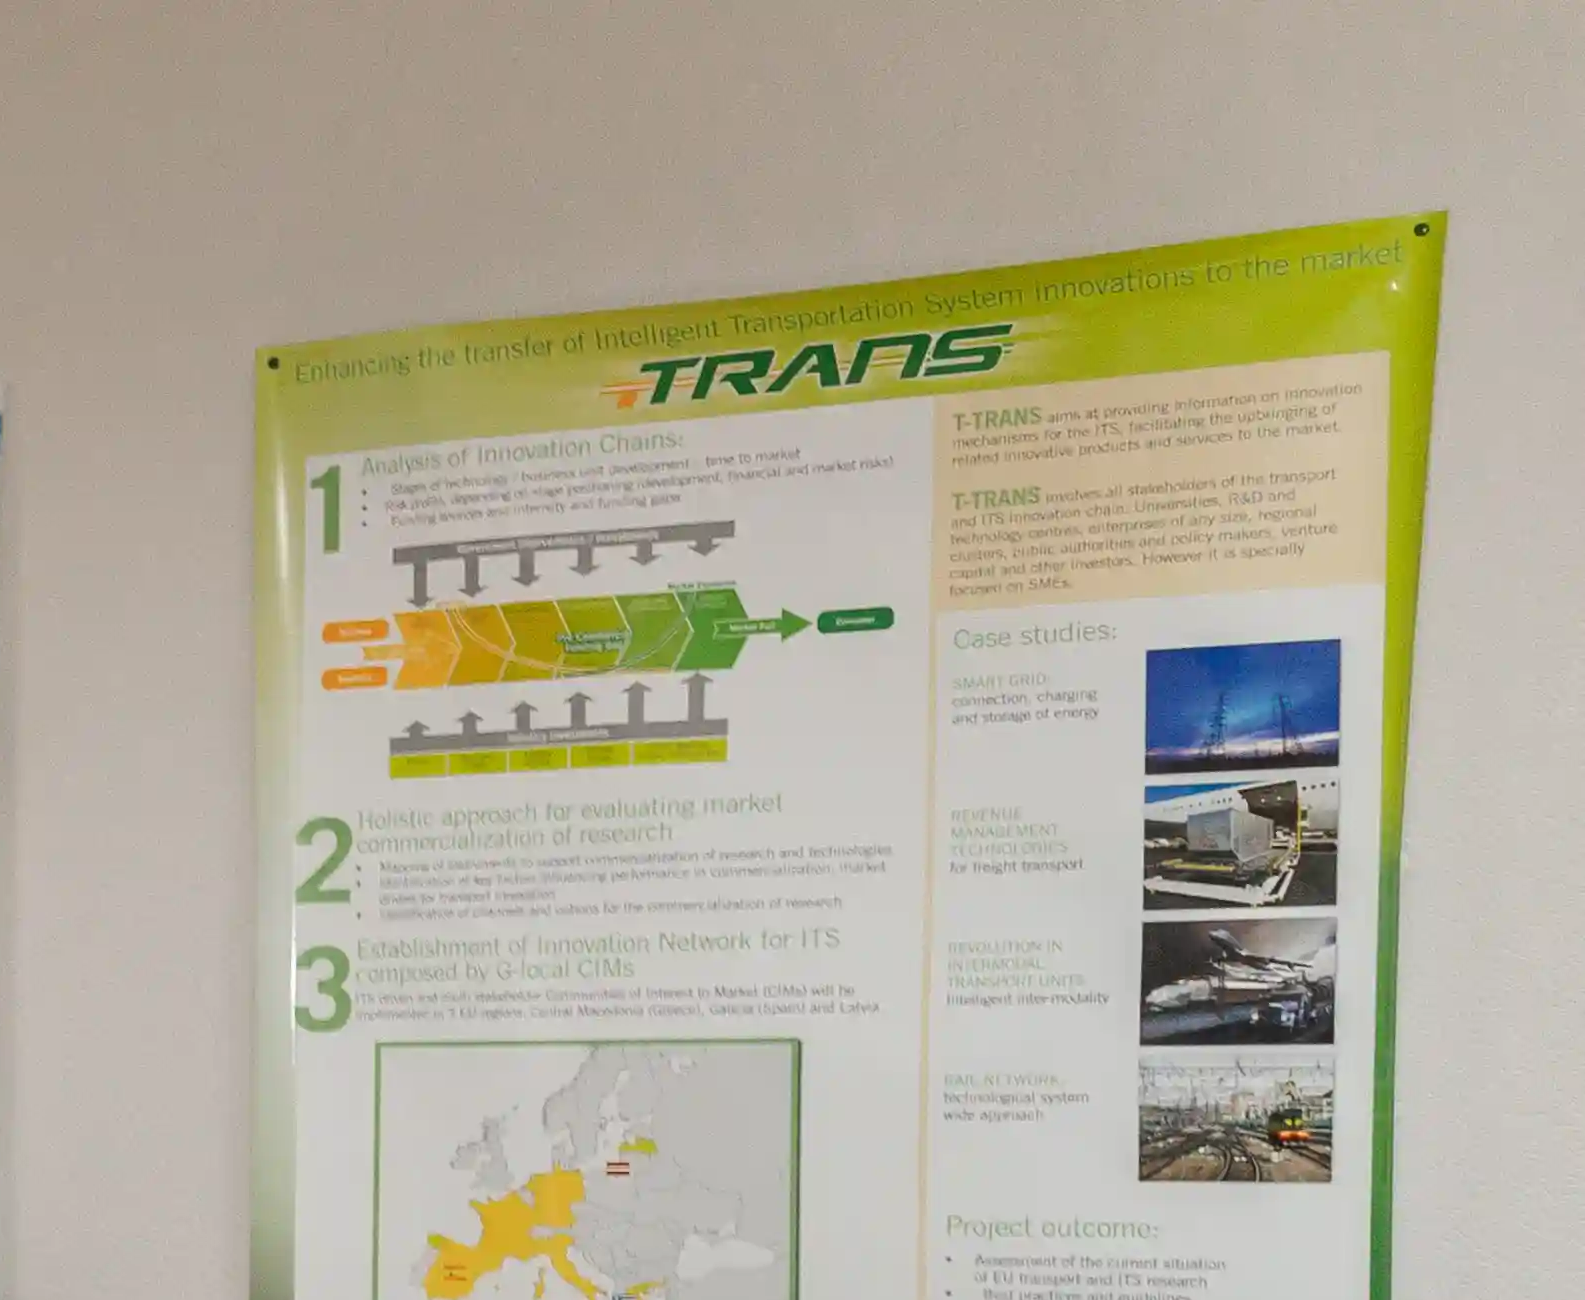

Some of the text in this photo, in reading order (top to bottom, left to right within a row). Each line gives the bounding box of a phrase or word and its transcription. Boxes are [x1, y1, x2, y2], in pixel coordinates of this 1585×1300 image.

[296, 239, 1401, 384] Enhancing the transfer of Intelligent Transportation System innovations to the market
[953, 405, 1042, 433] T-TRANS
[361, 432, 683, 478] Analysis of Innovation Chains:
[308, 465, 342, 554] 1
[952, 486, 1041, 511] T-TRANS
[954, 620, 1116, 650] Case studies:
[358, 792, 782, 831] Holistic approach for evaluating market
[357, 822, 672, 854] commercialization of research
[294, 816, 353, 905] 2
[358, 927, 840, 963] Establishment of Innovation Network for ITS
[294, 945, 352, 1033] 3
[947, 1214, 1158, 1242] Project outcome:
